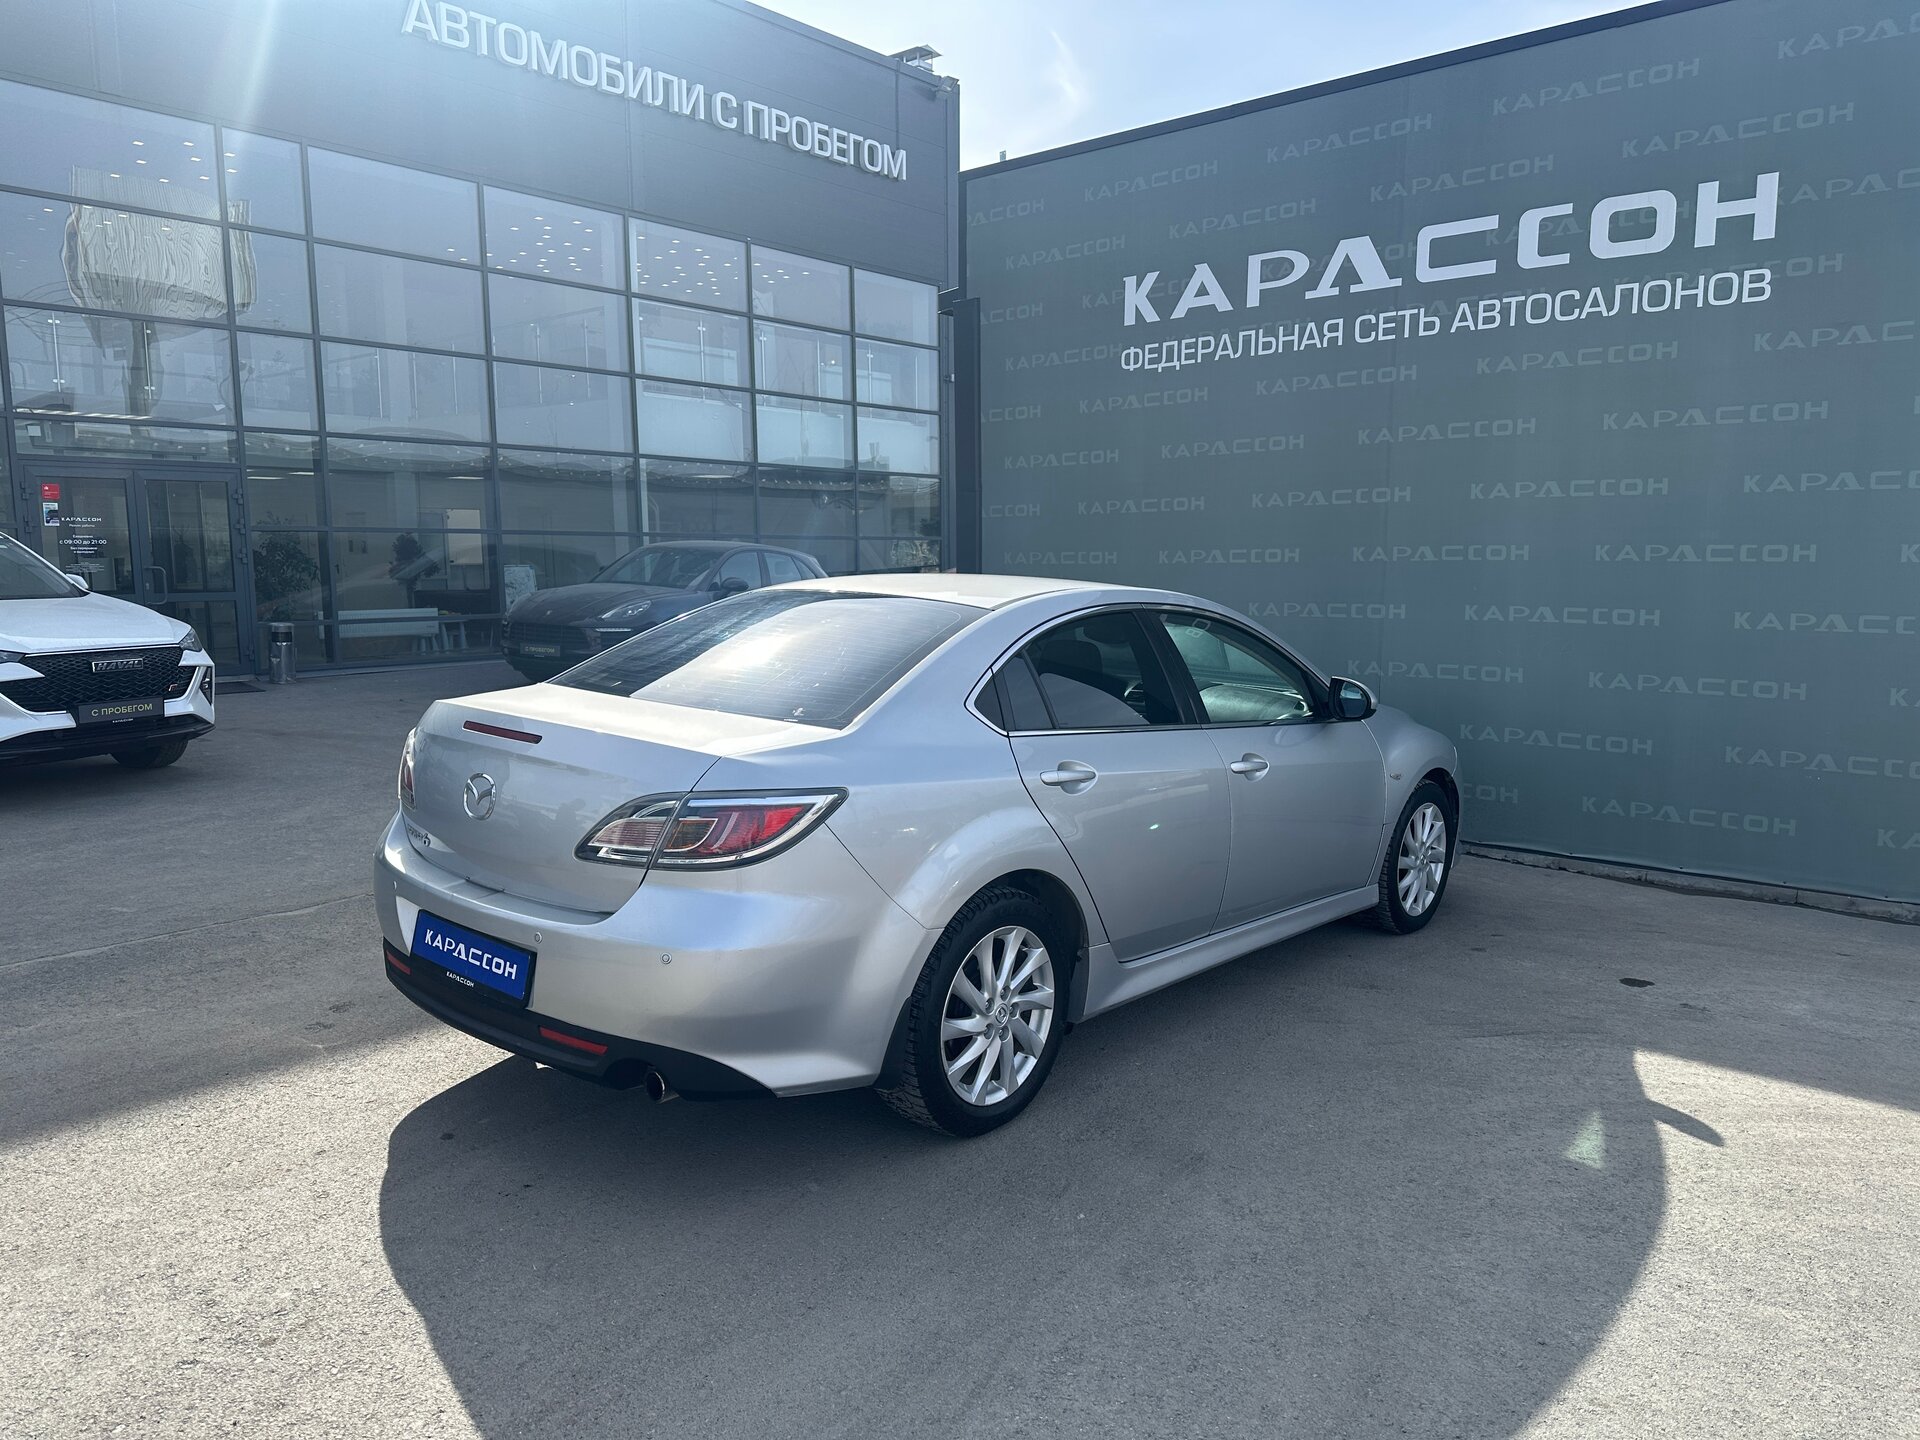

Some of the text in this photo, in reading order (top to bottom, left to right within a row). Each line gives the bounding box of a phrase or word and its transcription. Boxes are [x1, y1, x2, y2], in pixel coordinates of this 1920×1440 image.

[402, 0, 907, 181] АВТОМОБИЛИ С ПРОБЕГОМ
[1492, 57, 1700, 116] КАРАССОН
[1266, 113, 1432, 164] КАРАССОН
[1621, 102, 1855, 158] КАРАССОН
[1083, 160, 1219, 202] КАРАССОН
[1370, 153, 1555, 202] КАРАССОН
[1169, 198, 1317, 240] КАРАССОН
[1005, 234, 1126, 270] КАРАССОН
[1123, 172, 1780, 326] КАРАССОН
[1121, 318, 1344, 372] ФЕДЕРАЛЬНАЯ
[1354, 308, 1441, 344] СЕТЬ
[1450, 268, 1773, 334] АВТОСАЛОНОВ
[1476, 341, 1679, 375] КАРАССОН
[1256, 364, 1418, 396] КАРАССОН
[980, 404, 1042, 423] ССОН
[1079, 386, 1209, 415] КАРАССОН
[1603, 400, 1830, 431] КАРАССОН
[1161, 433, 1305, 460] КАРАССОН
[1358, 417, 1537, 447] КАРАССОН
[1004, 448, 1120, 470] КАРАССОН
[1252, 486, 1412, 508] КАРАССОН
[1470, 477, 1669, 500] КАРАССОН
[981, 503, 1041, 518] ССОН
[1078, 496, 1206, 515] КАРАССОН
[1004, 551, 1118, 565] КАРАССОН
[1158, 547, 1300, 564] КАРАССОН
[1352, 545, 1530, 563] КАРАССОН
[1595, 544, 1818, 563] КАРАССОН
[1248, 601, 1407, 620] КАРАССОН
[1465, 604, 1661, 626] КАРАССОН
[96, 660, 142, 672] HAVAL
[1347, 660, 1525, 684] КАРАССОН
[1588, 671, 1808, 701] КАРАССОН
[91, 703, 153, 717] С ПРОБЕГОМ
[1459, 724, 1653, 756] КАРАССОН
[1582, 796, 1798, 837] КАРАССОН
[425, 928, 518, 980] КАРАССОН
[446, 971, 475, 988] КАРАССОН
